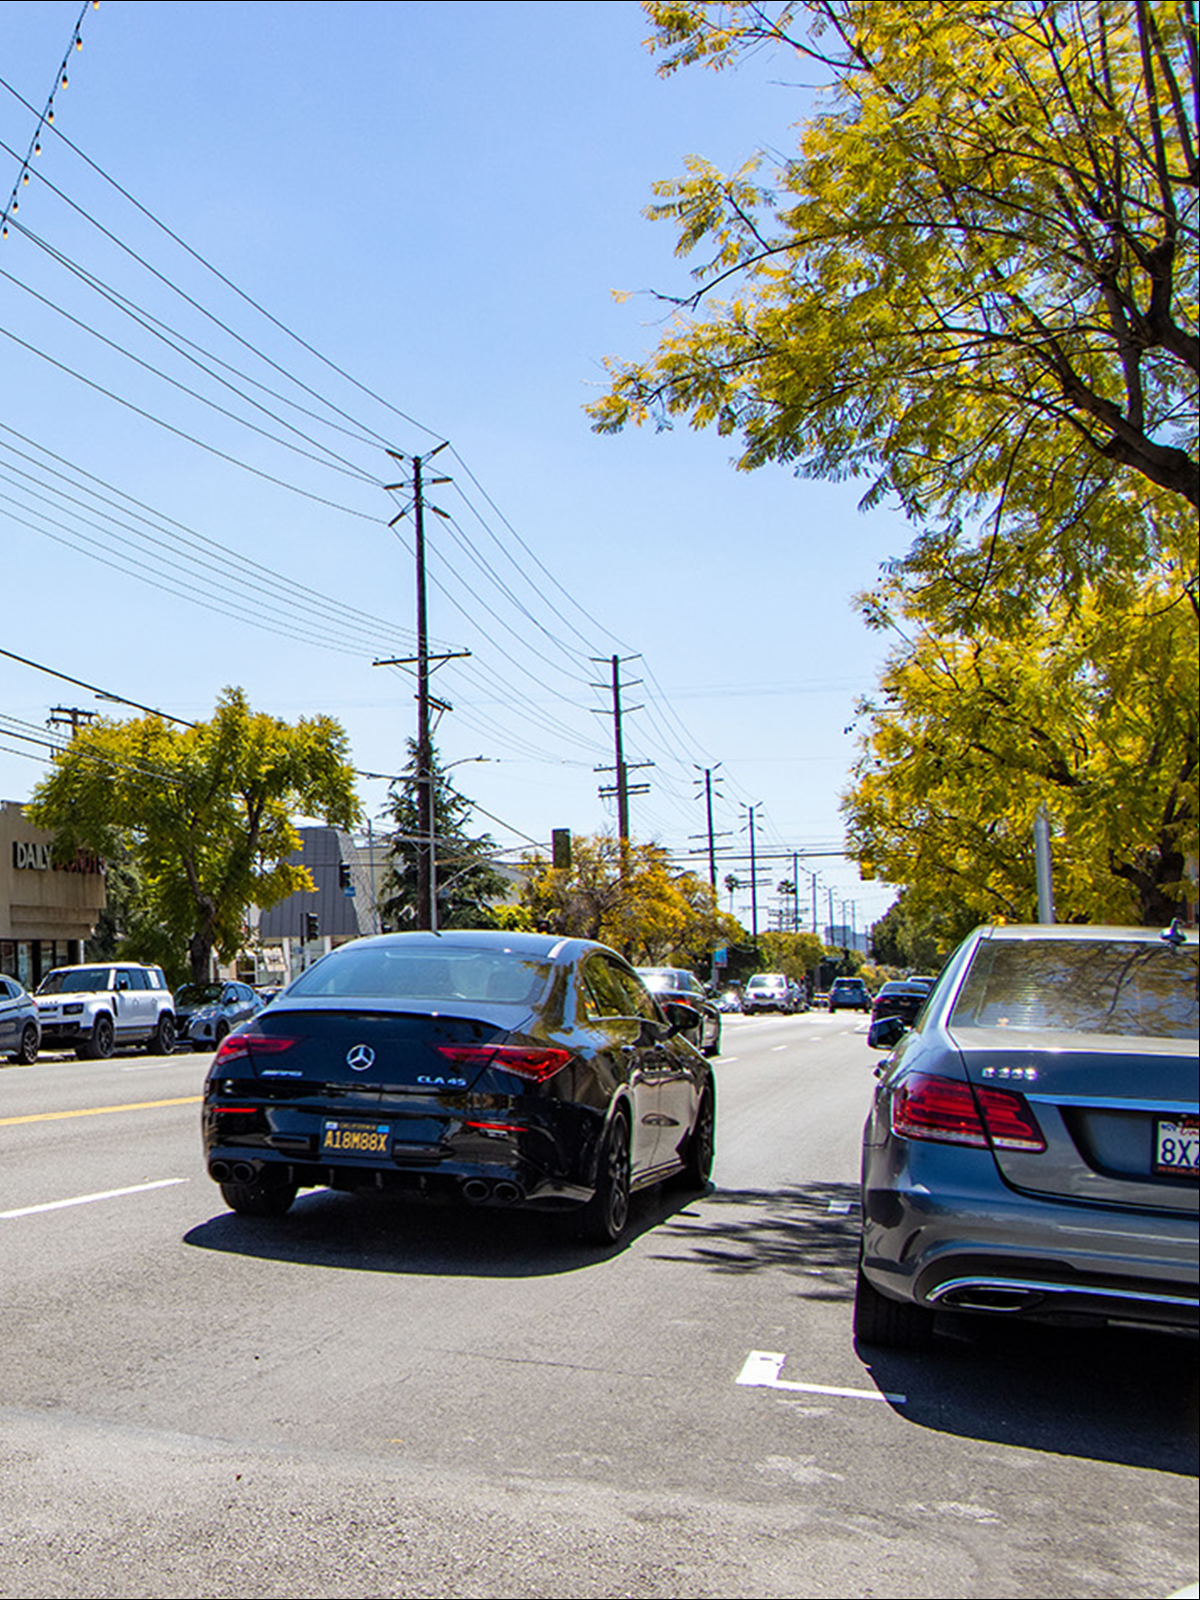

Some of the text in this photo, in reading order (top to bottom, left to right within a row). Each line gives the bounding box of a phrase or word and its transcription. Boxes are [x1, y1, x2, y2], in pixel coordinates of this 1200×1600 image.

[14, 841, 53, 870] DAILY
[417, 1075, 445, 1085] CLA
[323, 1130, 388, 1152] A18M88X
